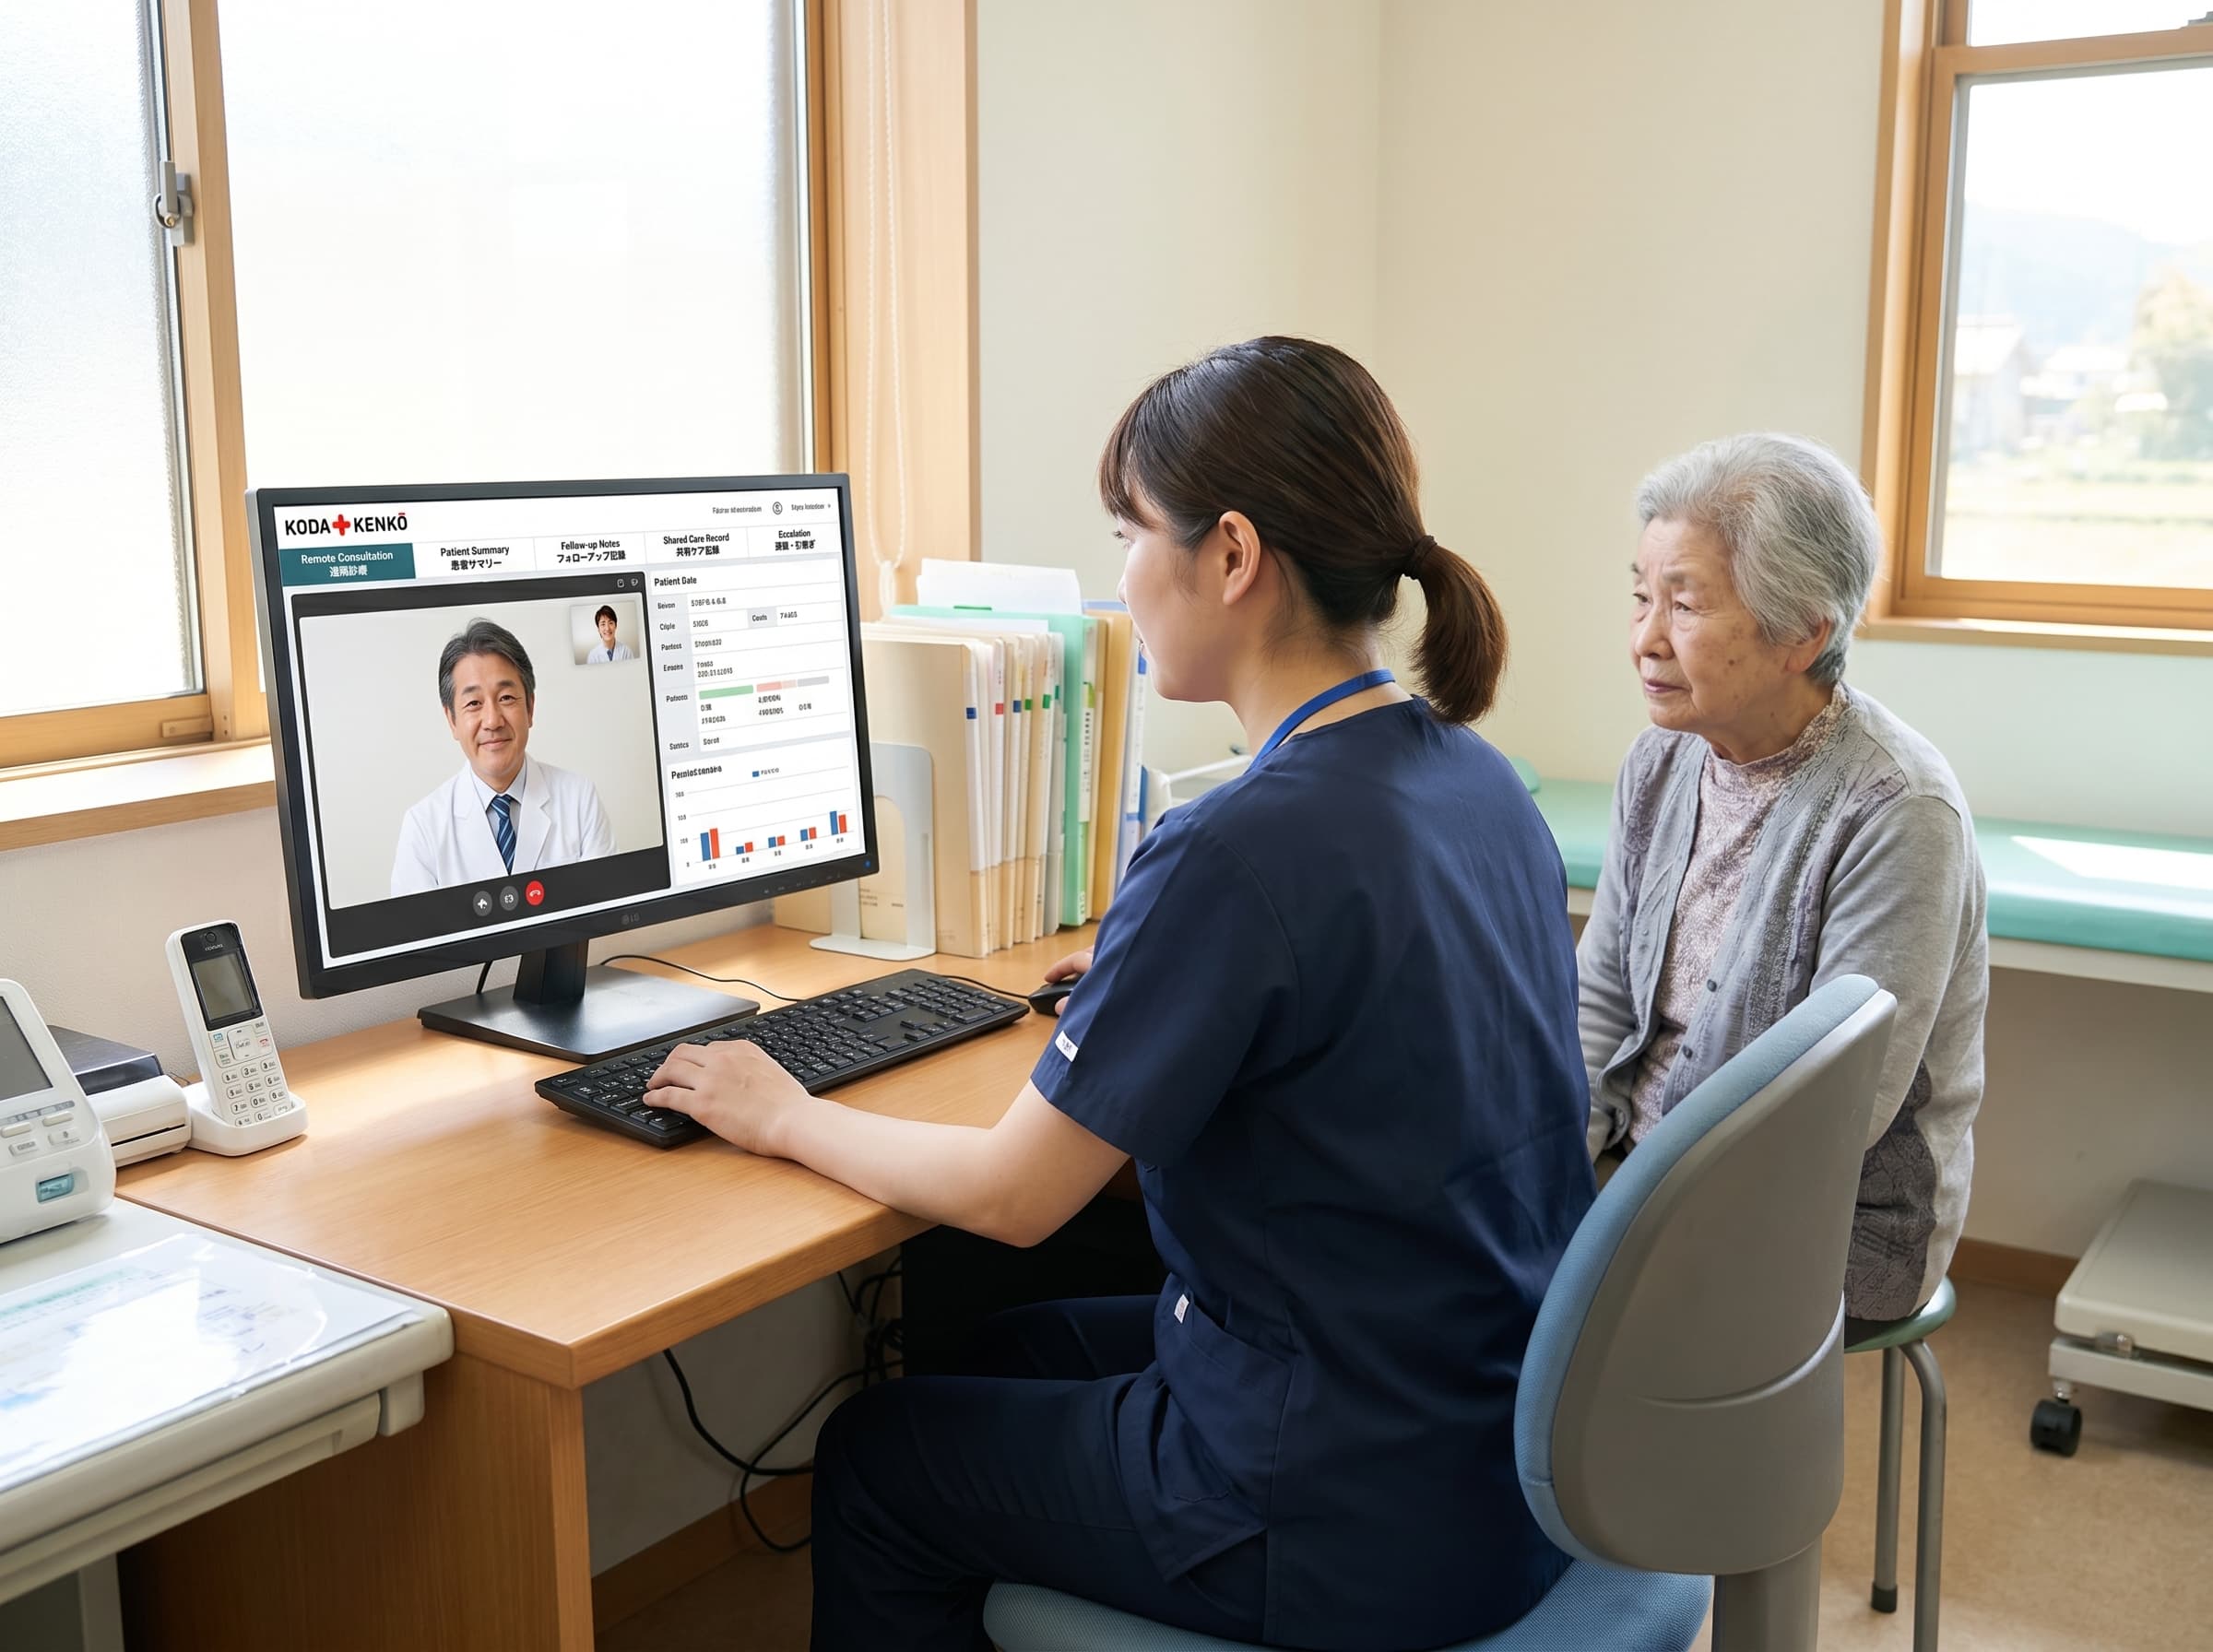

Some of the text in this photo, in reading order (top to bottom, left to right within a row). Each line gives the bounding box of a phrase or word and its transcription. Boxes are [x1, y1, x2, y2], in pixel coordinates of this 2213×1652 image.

[285, 513, 408, 536] KODA KENKŌ
[598, 539, 621, 549] Notes
[663, 532, 729, 545] Shared Care Record
[302, 550, 394, 564] Remote Consultation
[441, 545, 510, 557] Patient Summary
[654, 576, 680, 586] Patient
